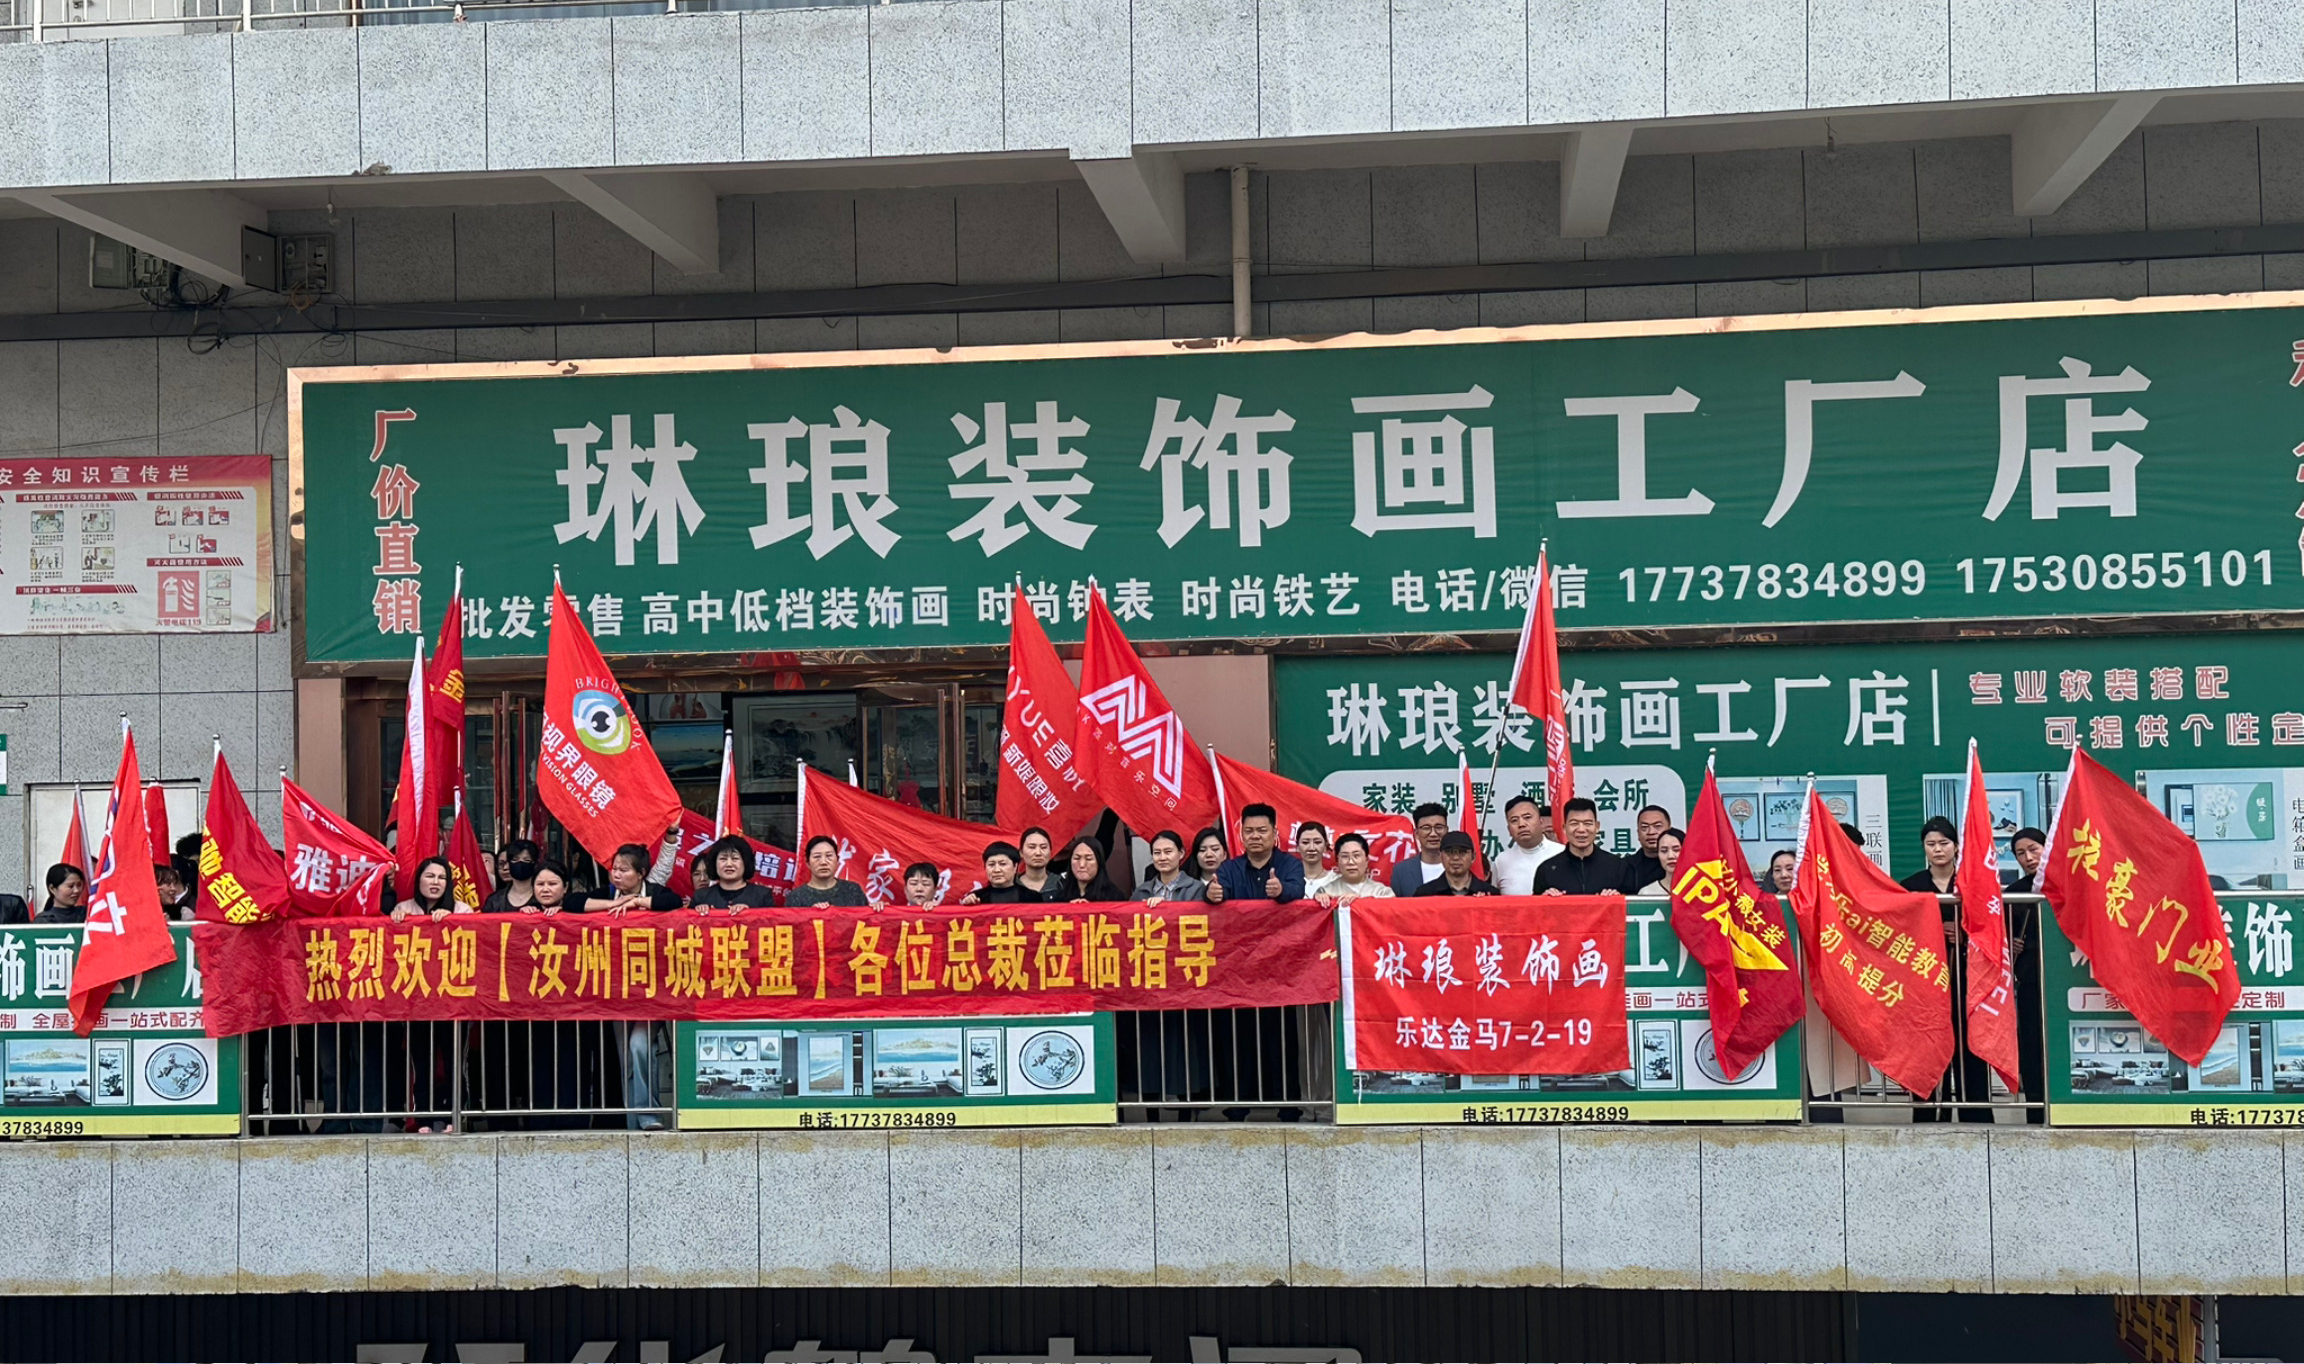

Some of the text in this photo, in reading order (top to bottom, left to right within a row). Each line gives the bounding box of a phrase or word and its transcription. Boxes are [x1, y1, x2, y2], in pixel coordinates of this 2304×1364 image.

[0, 464, 190, 487] 安全知识宣传栏
[553, 356, 2152, 566] 琳琅装饰画工厂店
[370, 407, 422, 635] 厂价直销
[641, 585, 949, 636] 高中低档装饰画
[1182, 572, 1361, 619] 时尚铁艺
[1391, 563, 1589, 613] 电话/微信
[1619, 559, 1926, 604] 17737834899
[1956, 549, 2274, 594] 17530855101
[1969, 665, 2230, 704] 专业软装搭配
[1326, 669, 1909, 758] 琳琅装饰画工厂店
[541, 711, 617, 811] 视界眼镜
[566, 782, 599, 819] GLASSES
[1363, 783, 1416, 813] 家装
[1593, 778, 1650, 812] 会所
[305, 913, 1217, 1002] 热烈欢迎【汝州同城联盟】各位总裁莅临指导
[1373, 933, 1609, 998] 琳琅装饰画
[32, 1010, 205, 1029] 全屋画一站式配齐
[1395, 1017, 1592, 1052] 乐达金马7-2-19
[799, 1111, 957, 1128] 电话:17737834899
[1462, 1106, 1630, 1124] 电话:17737834899
